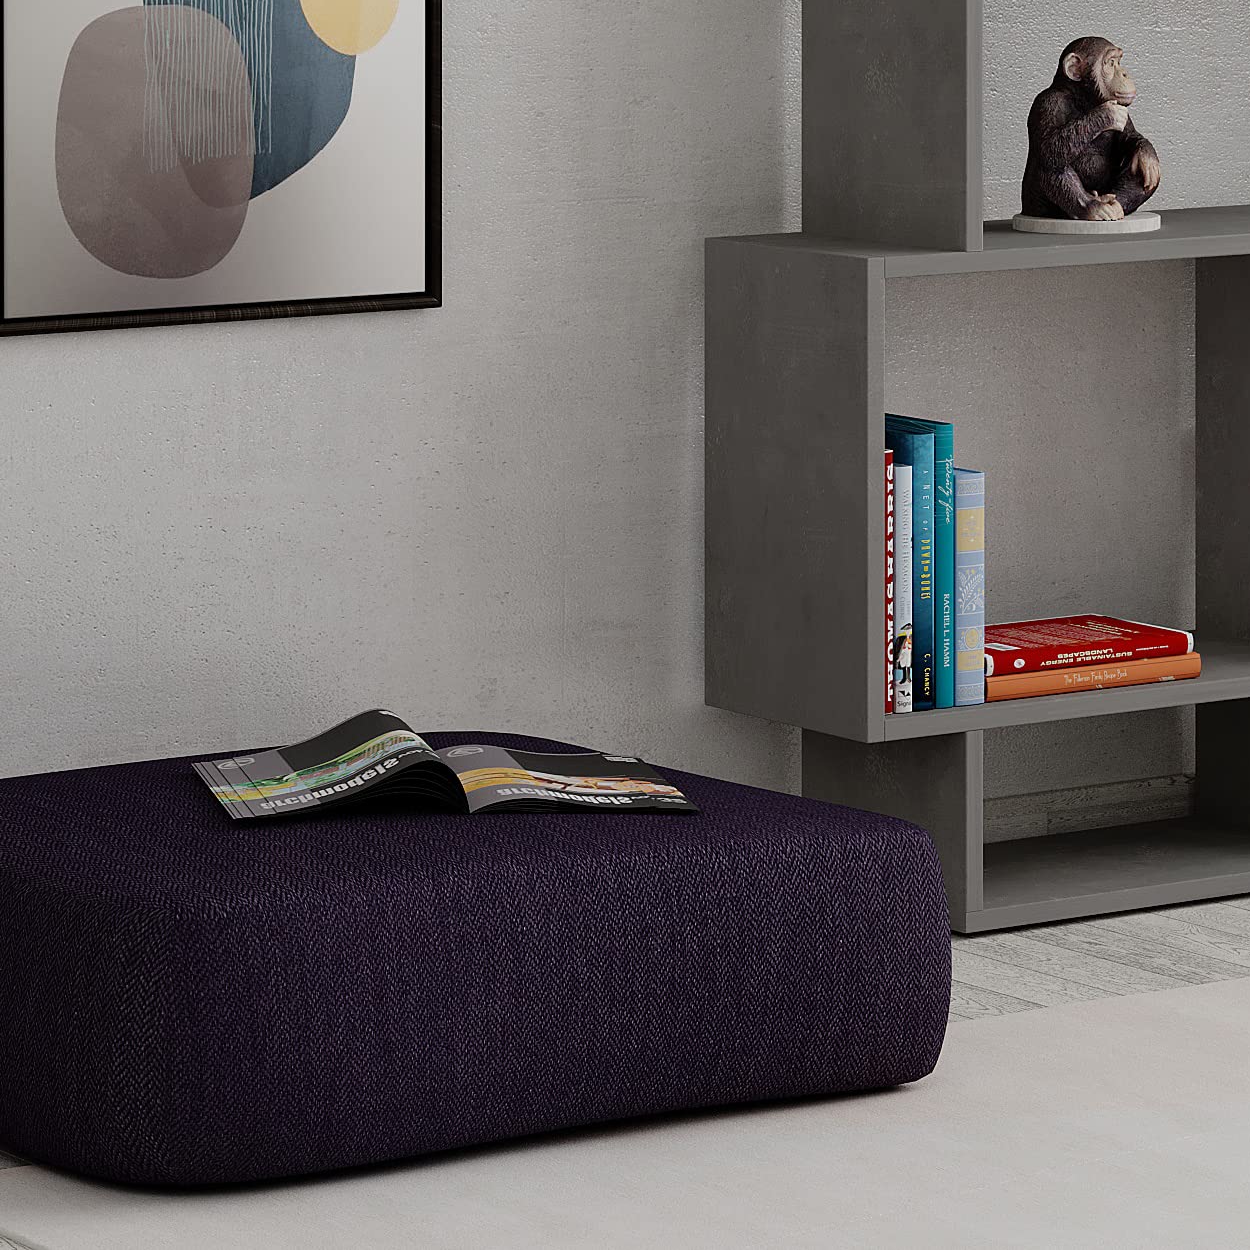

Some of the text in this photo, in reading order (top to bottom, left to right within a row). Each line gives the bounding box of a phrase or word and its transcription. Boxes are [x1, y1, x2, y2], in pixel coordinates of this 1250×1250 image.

[924, 654, 930, 662] C.
[1058, 648, 1113, 658] LANDSCAPES
[1040, 651, 1133, 666] SUSTAINABLE ENERGY
